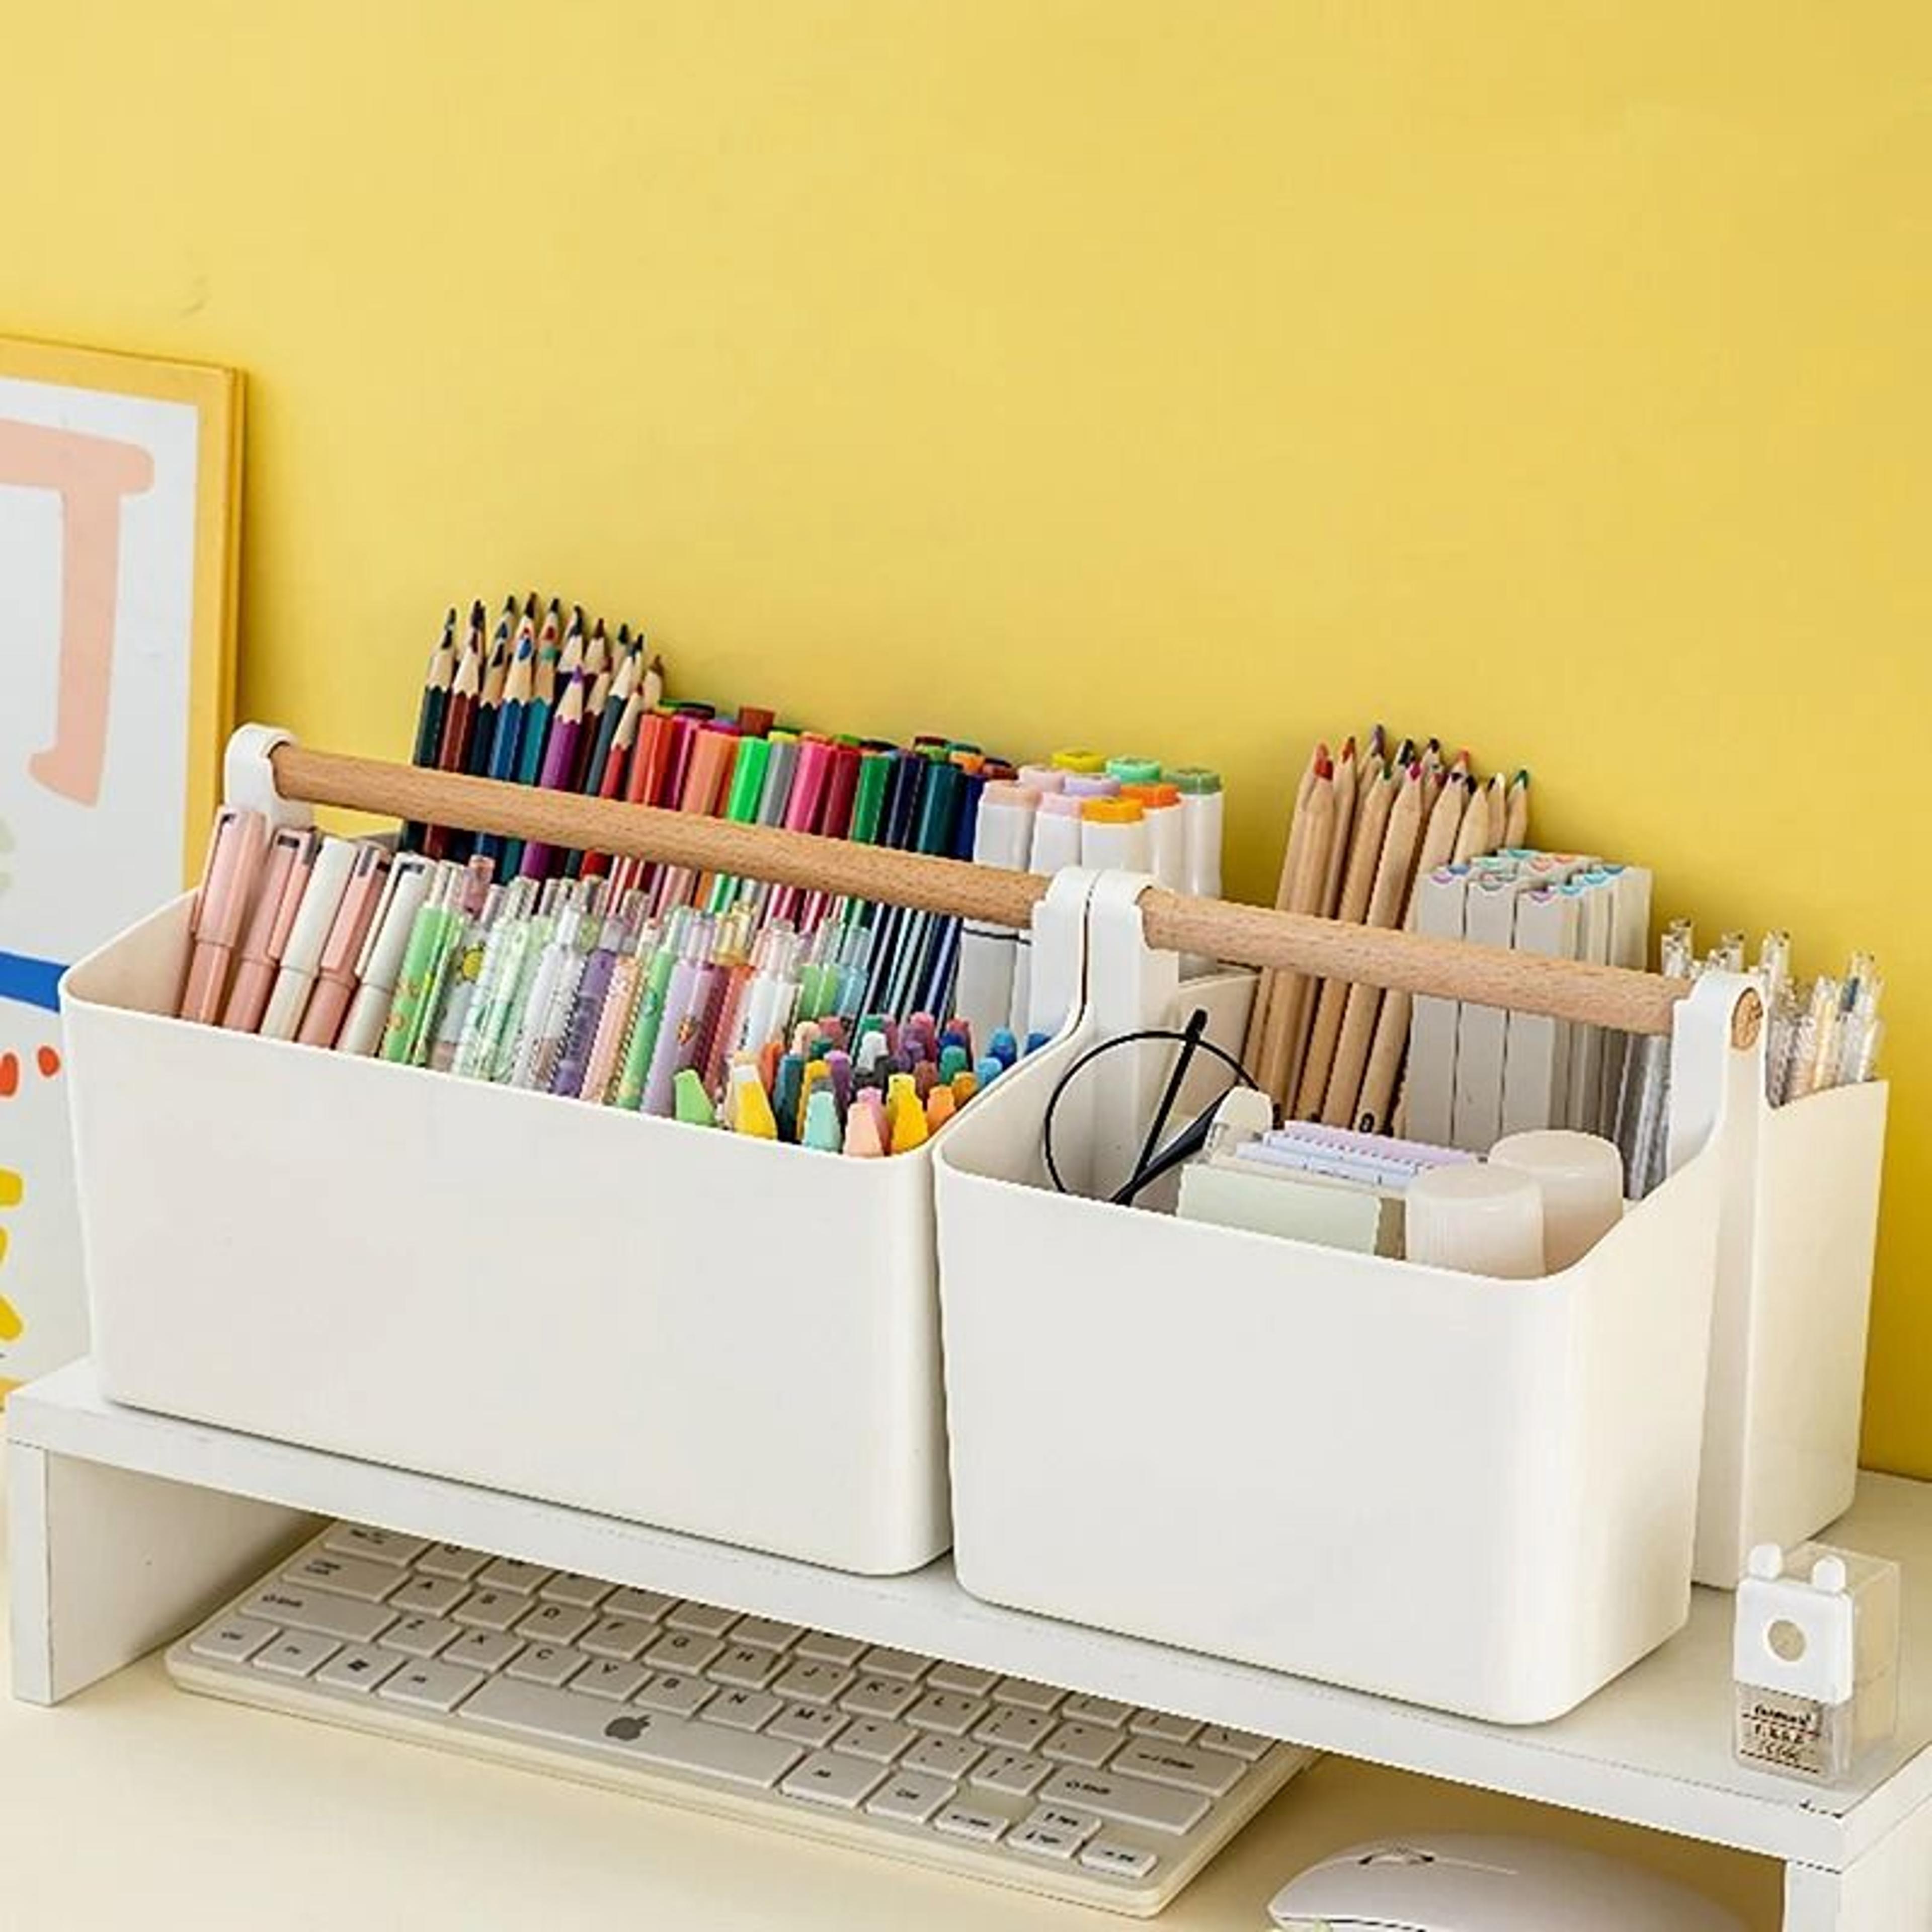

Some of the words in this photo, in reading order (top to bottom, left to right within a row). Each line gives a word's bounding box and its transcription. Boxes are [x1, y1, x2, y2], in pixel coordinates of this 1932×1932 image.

[407, 1620, 425, 1630] Z
[536, 1649, 553, 1659] C
[736, 1651, 754, 1661] H
[802, 1667, 819, 1677] J
[866, 1681, 884, 1692] K
[730, 1694, 748, 1704] N
[794, 1709, 815, 1719] M
